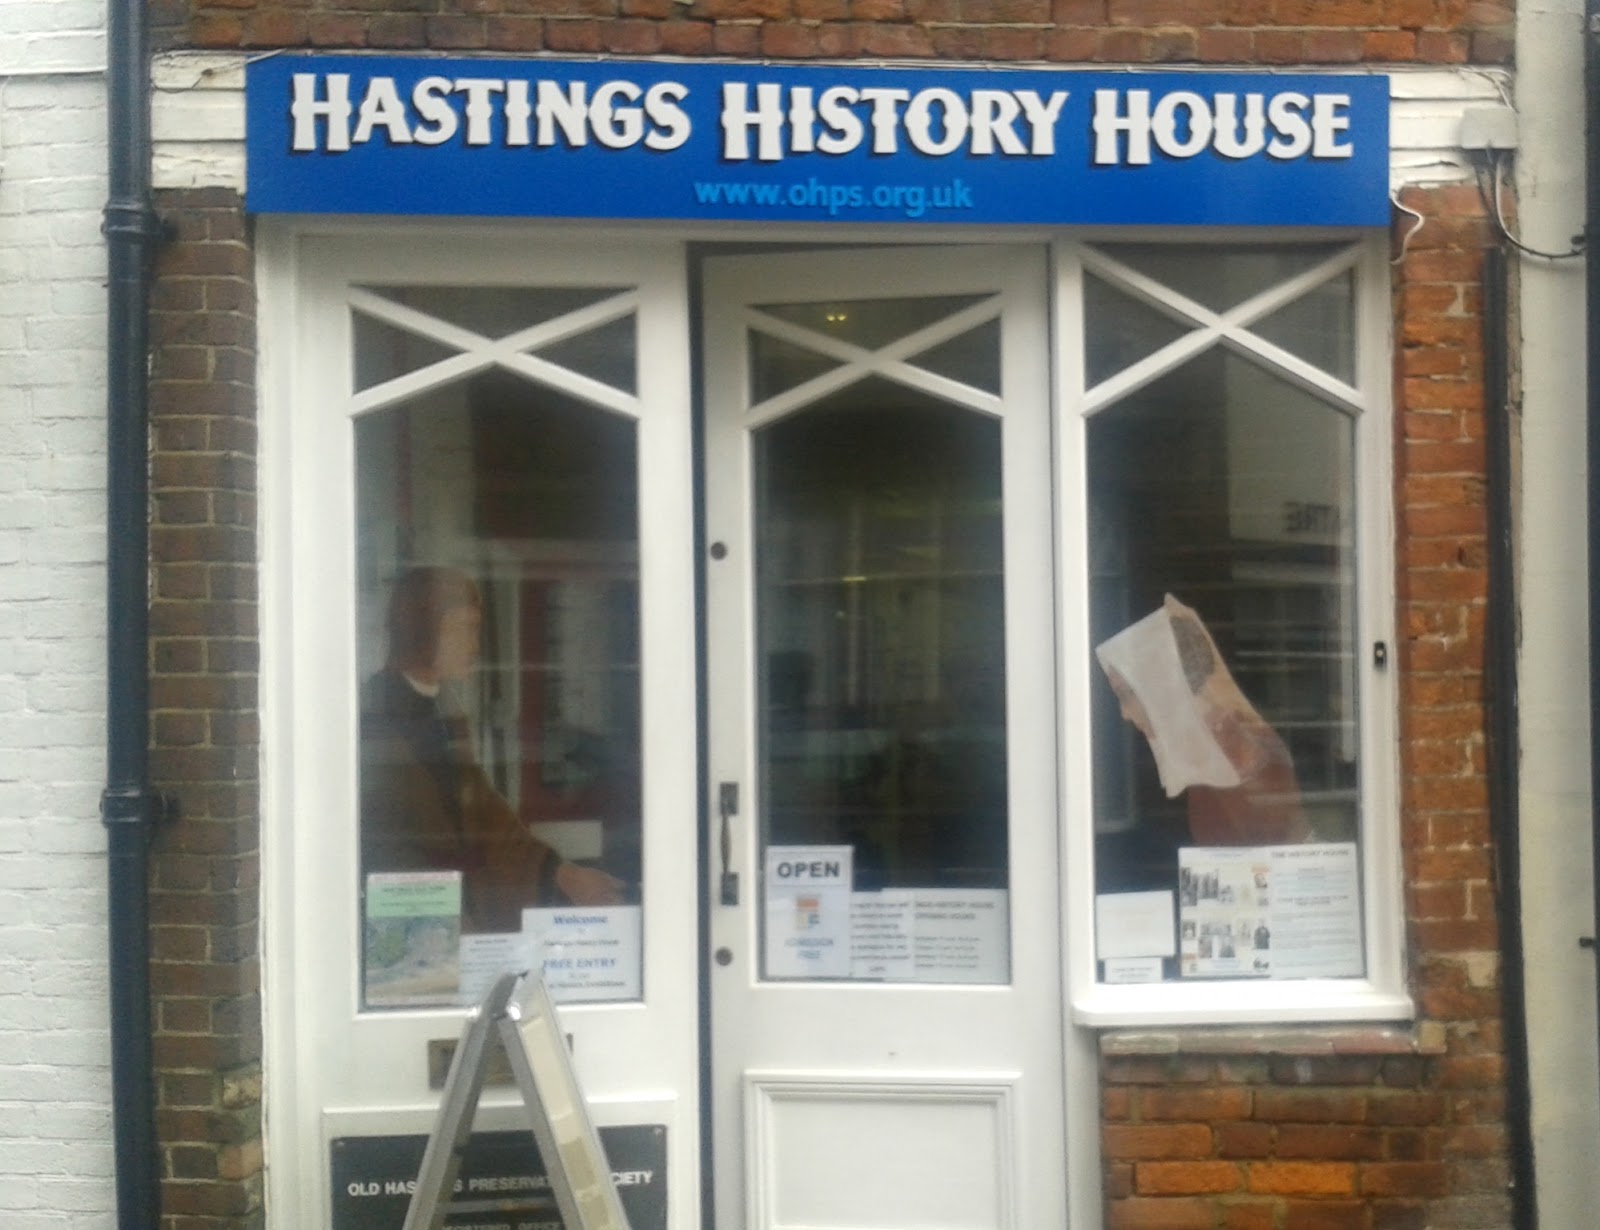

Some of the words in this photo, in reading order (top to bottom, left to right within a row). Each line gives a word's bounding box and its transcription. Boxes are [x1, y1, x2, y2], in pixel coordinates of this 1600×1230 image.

[291, 73, 691, 151] HASTINGS
[721, 82, 1069, 161] HISTORY
[1093, 89, 1354, 165] HOUSE
[694, 178, 973, 217] www.ohps.org.uk
[777, 861, 840, 878] OPEN
[553, 914, 608, 925] Welcome
[543, 959, 572, 968] FREE
[576, 958, 616, 968] ENTRY
[347, 1182, 380, 1197] OLD
[469, 1176, 548, 1192] PRESERVA
[610, 1170, 653, 1185] CIETY
